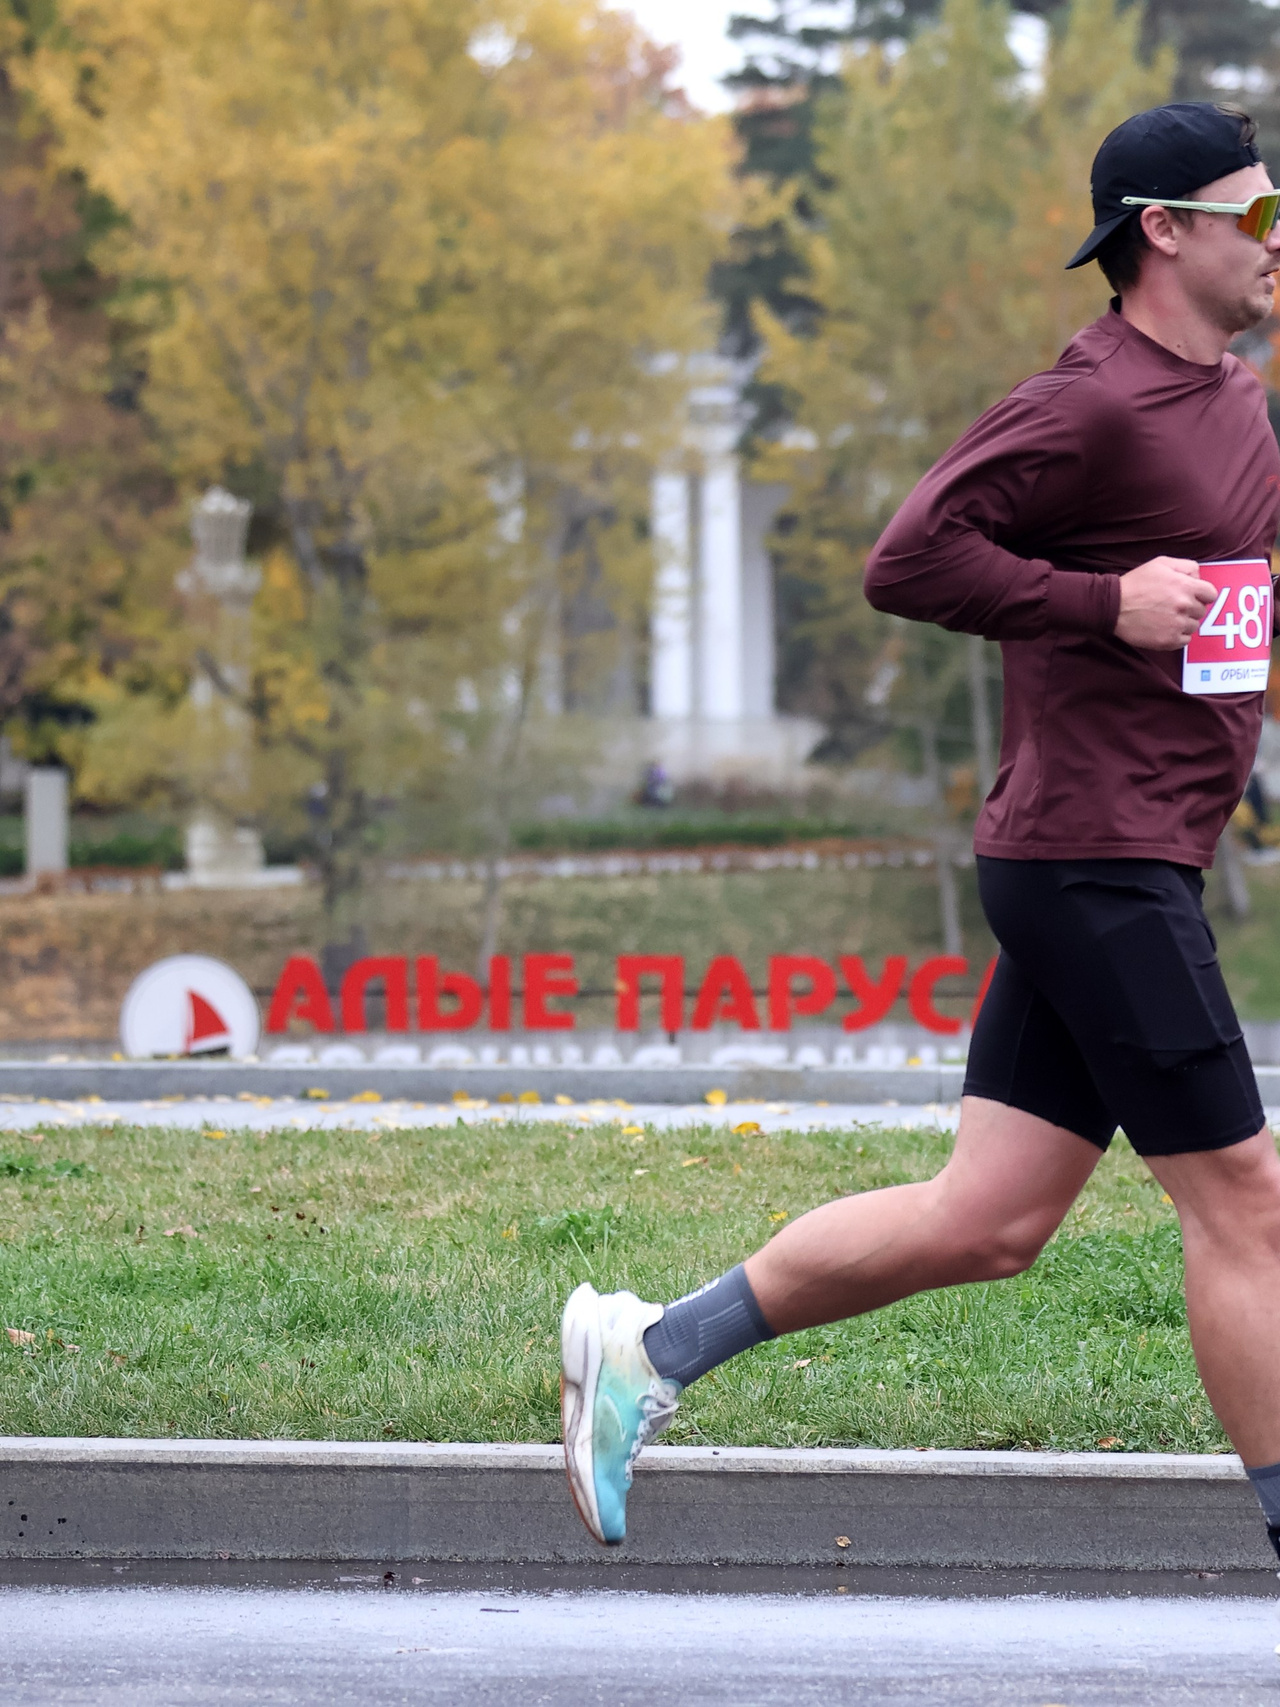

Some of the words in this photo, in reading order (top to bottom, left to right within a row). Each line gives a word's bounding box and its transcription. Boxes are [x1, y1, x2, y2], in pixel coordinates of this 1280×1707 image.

[1198, 584, 1271, 650] 487
[264, 954, 580, 1034] АЛЫЕ
[615, 953, 1000, 1036] ПАРУС
